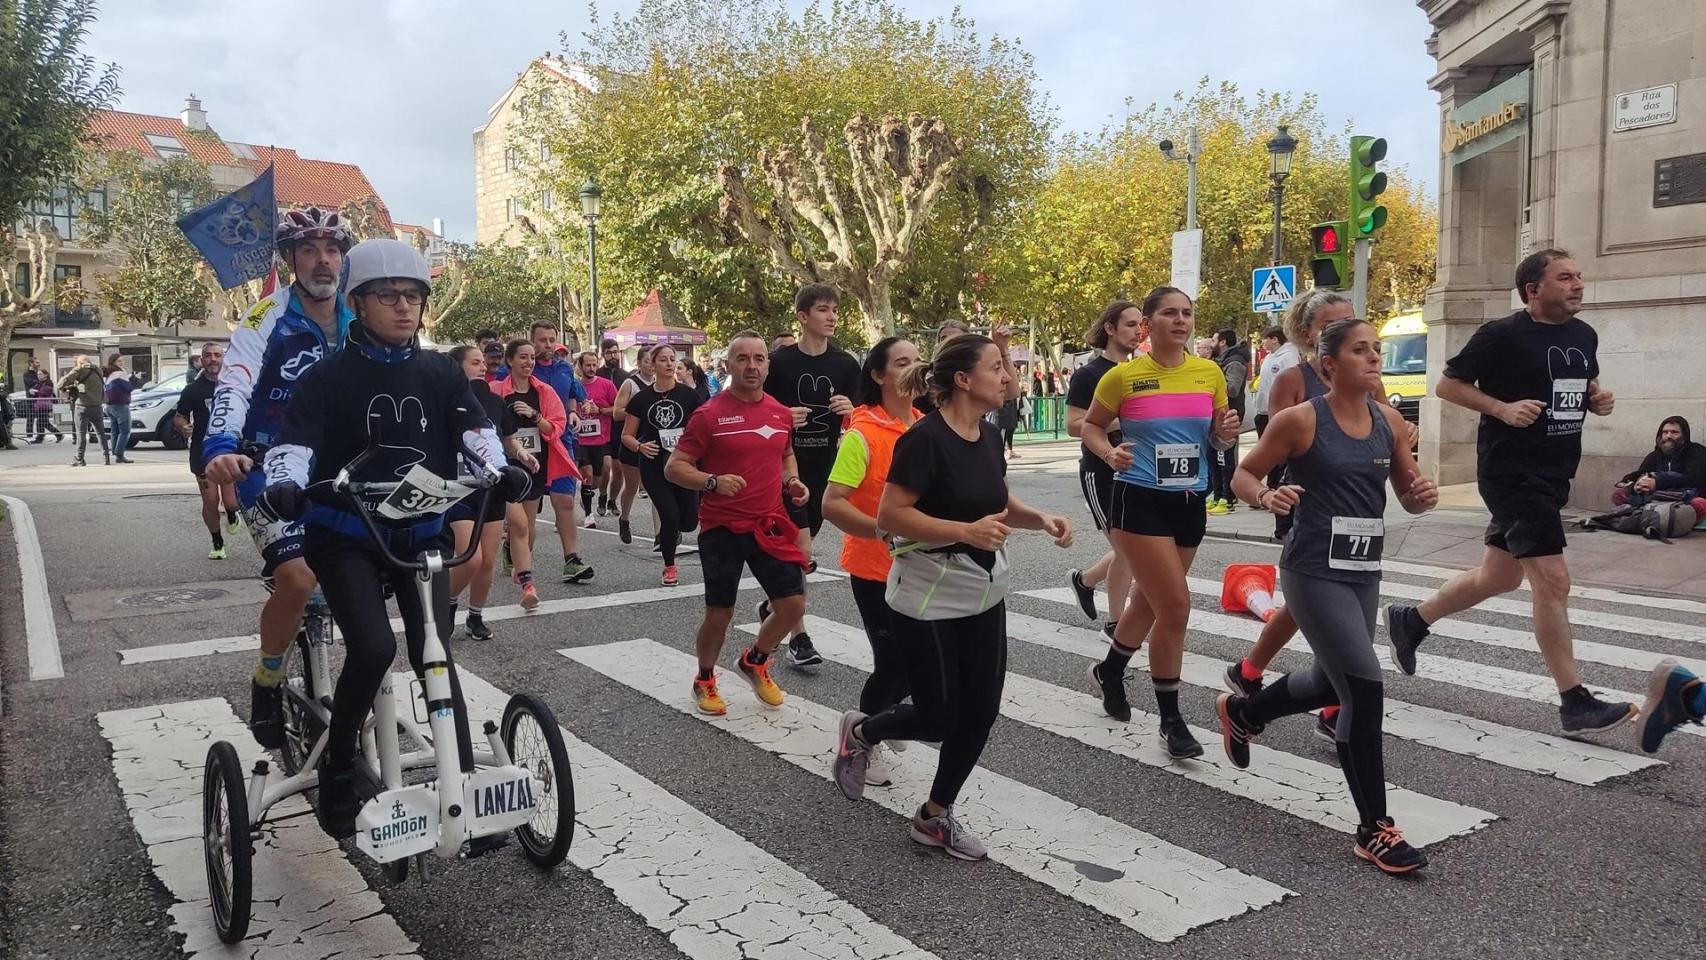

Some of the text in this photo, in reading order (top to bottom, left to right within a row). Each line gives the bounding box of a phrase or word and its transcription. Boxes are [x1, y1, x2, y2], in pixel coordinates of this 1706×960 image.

[1643, 102, 1660, 110] dos
[1455, 102, 1516, 146] Santander
[1619, 111, 1671, 126] Pescadores
[1560, 392, 1583, 408] 209
[1169, 458, 1189, 474] 78
[1349, 535, 1371, 556] 77
